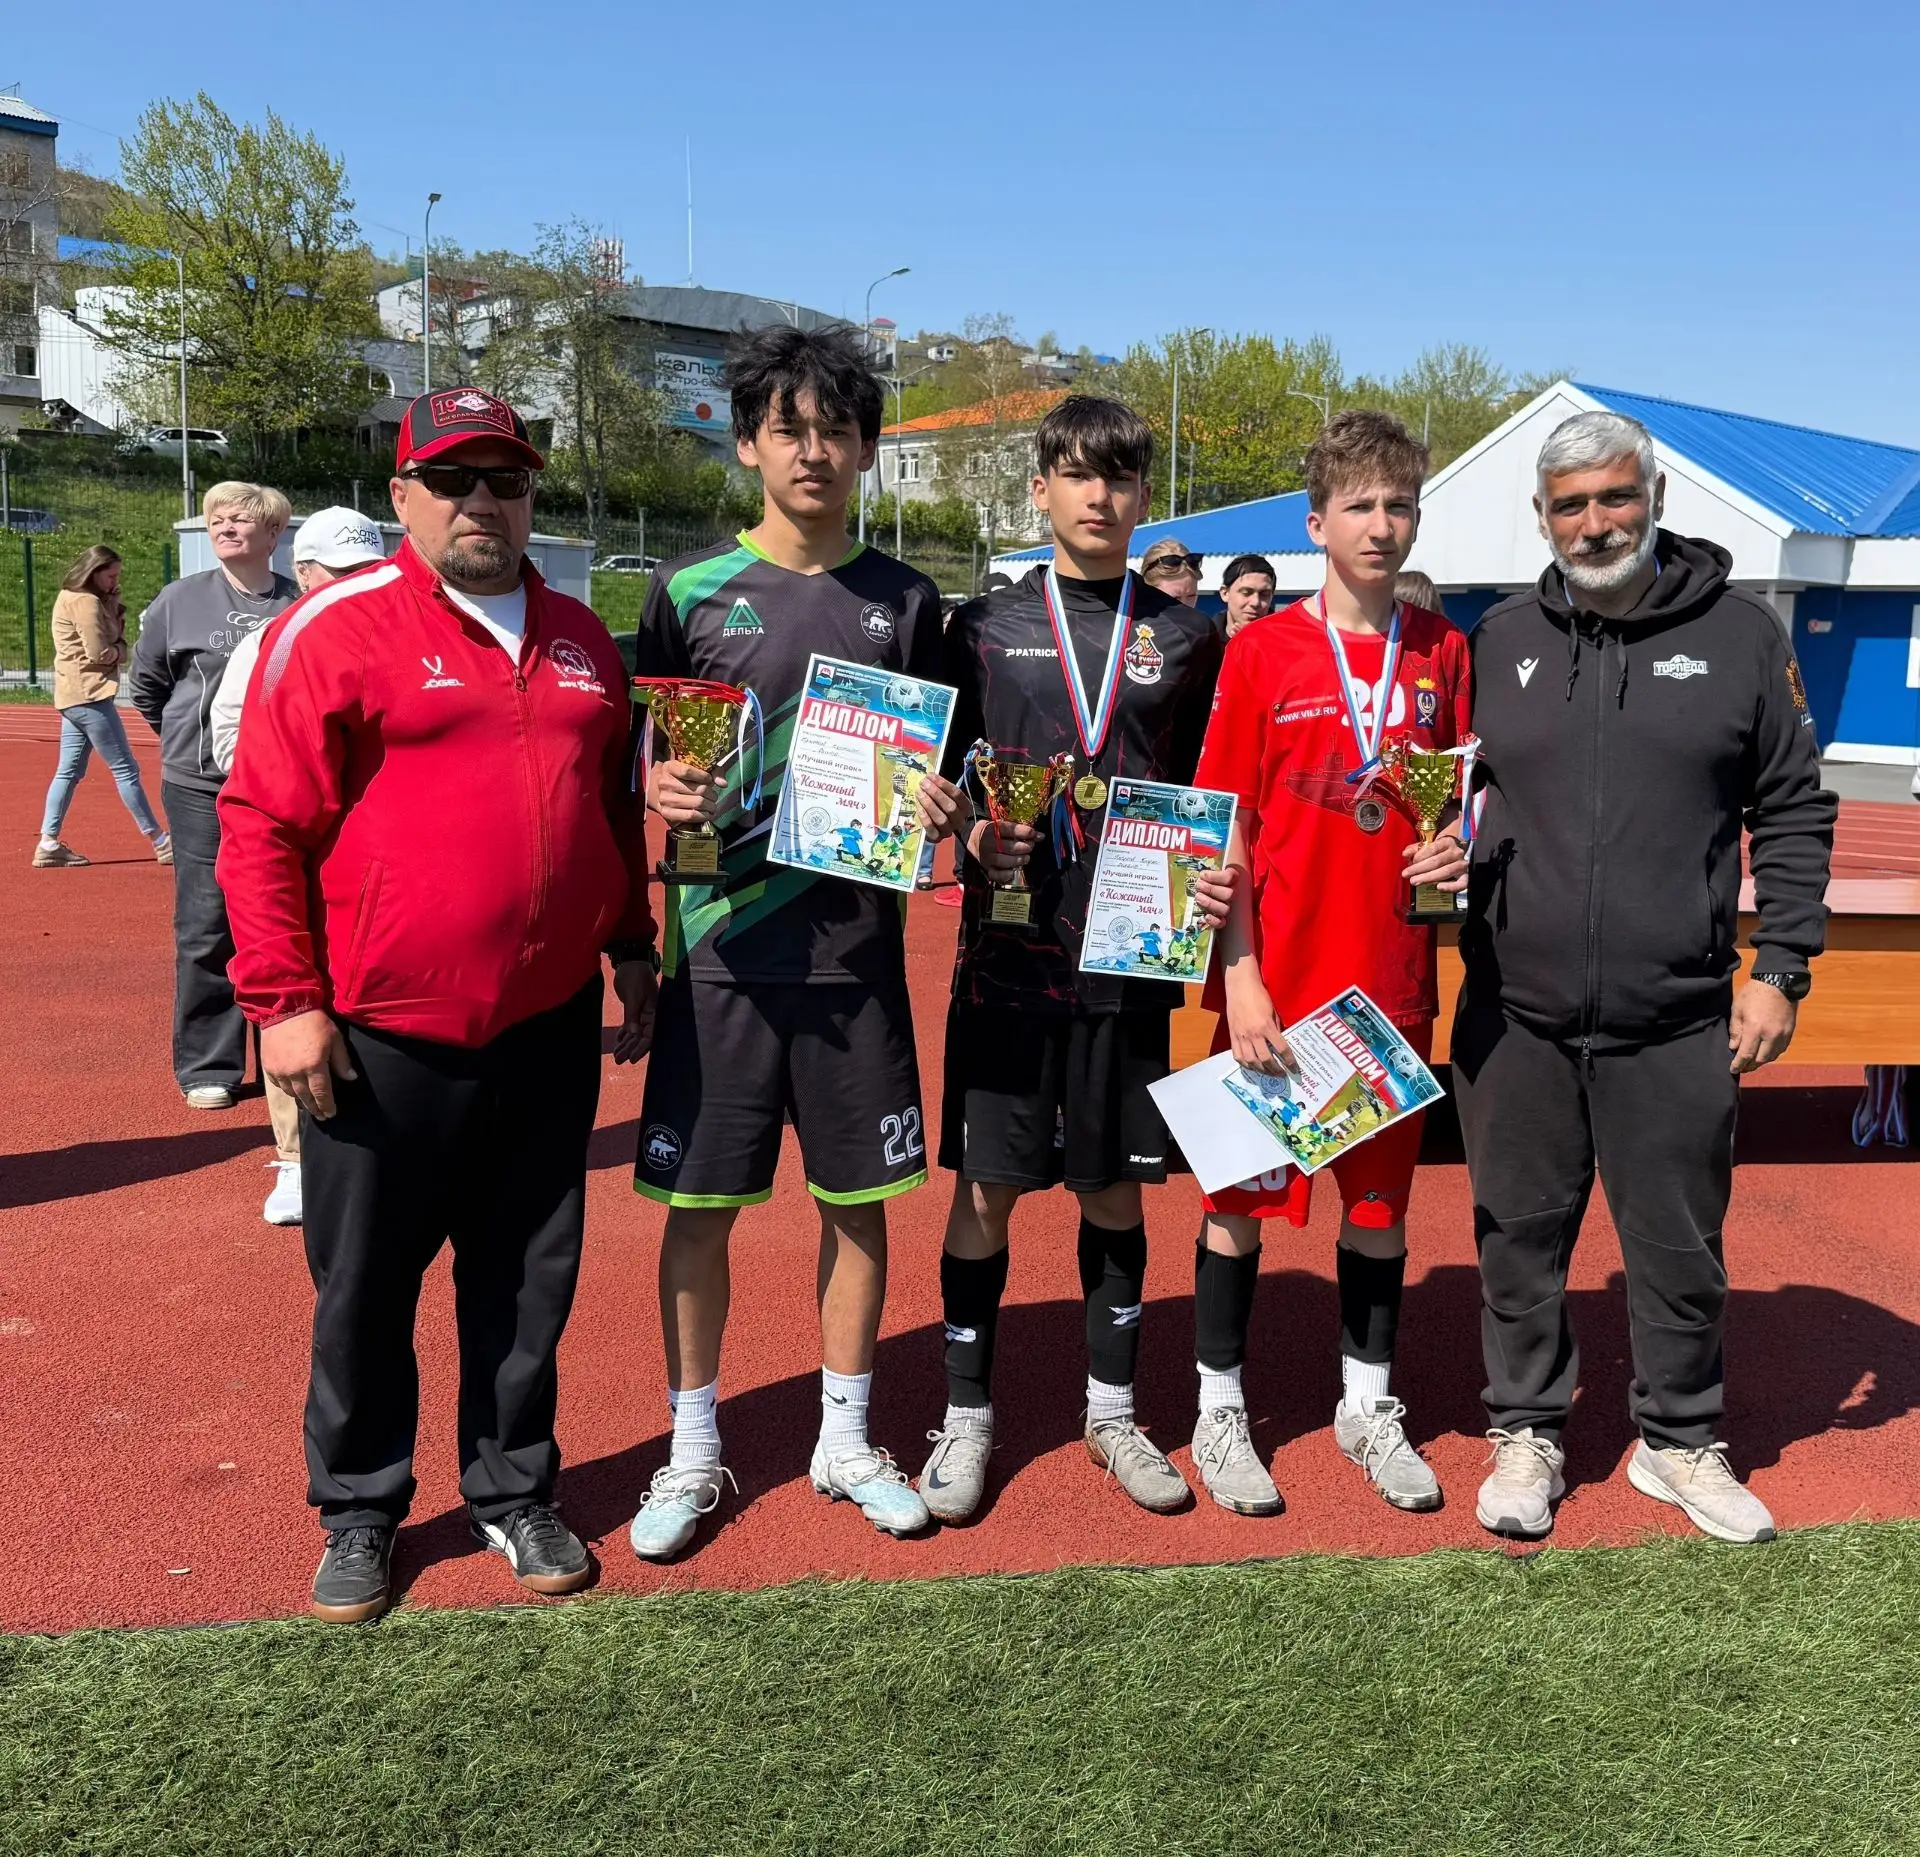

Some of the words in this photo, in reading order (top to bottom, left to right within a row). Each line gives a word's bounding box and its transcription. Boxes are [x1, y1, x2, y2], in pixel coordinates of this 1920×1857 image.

[436, 399, 457, 416] 19
[334, 526, 377, 540] MOTO
[336, 536, 380, 548] PARK
[722, 626, 765, 638] ДЕЛЬТА
[1015, 648, 1059, 658] PATRICK
[803, 700, 899, 743] ДИПЛОМ
[1106, 820, 1188, 851] ДИПЛОМ
[1099, 888, 1154, 904] «Кожаный
[1310, 1012, 1387, 1083] ДИПЛОМ
[880, 1106, 924, 1166] 22
